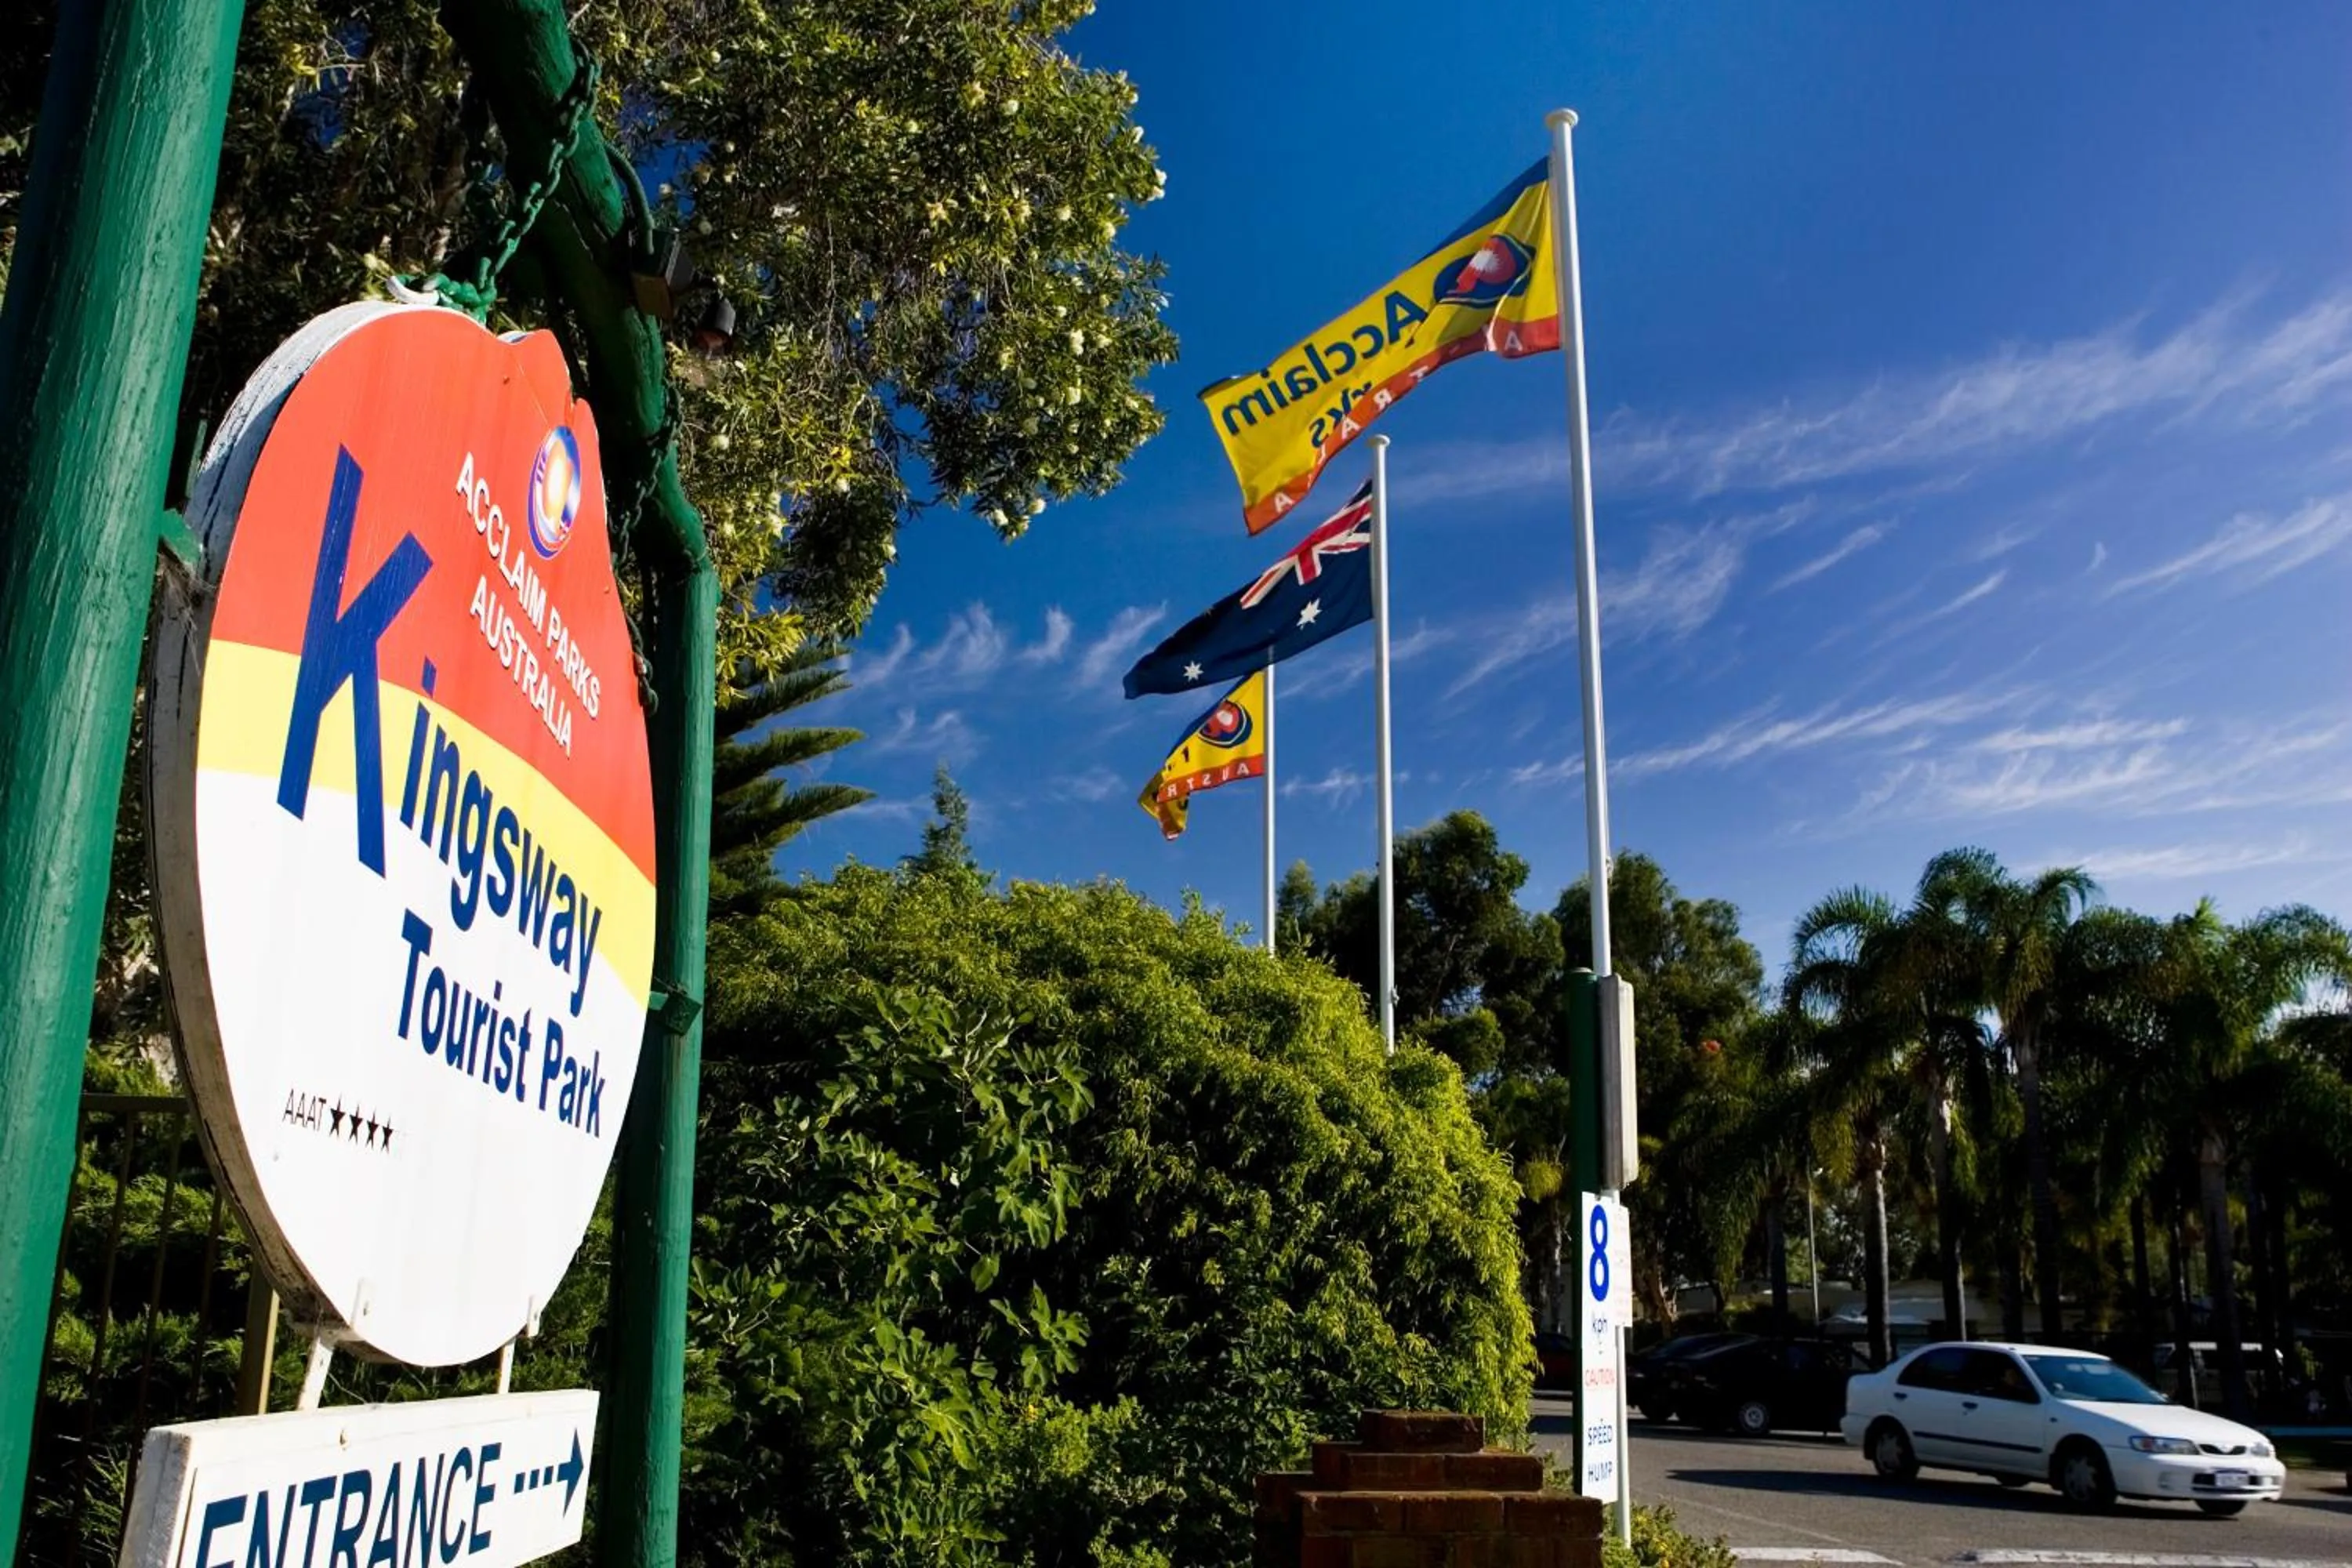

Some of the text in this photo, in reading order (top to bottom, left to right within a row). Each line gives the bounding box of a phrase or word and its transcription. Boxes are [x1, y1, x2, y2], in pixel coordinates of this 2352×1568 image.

[456, 452, 600, 719] ACCLAIM PARKS
[277, 442, 602, 1018] Kingsway
[470, 575, 572, 757] AUSTRALIA
[397, 907, 605, 1138] Tourist Park
[1588, 1204, 1610, 1302] 8
[1584, 1367, 1615, 1387] CAUTION
[1588, 1424, 1613, 1446] SPEED
[1588, 1460, 1613, 1483] HUMP
